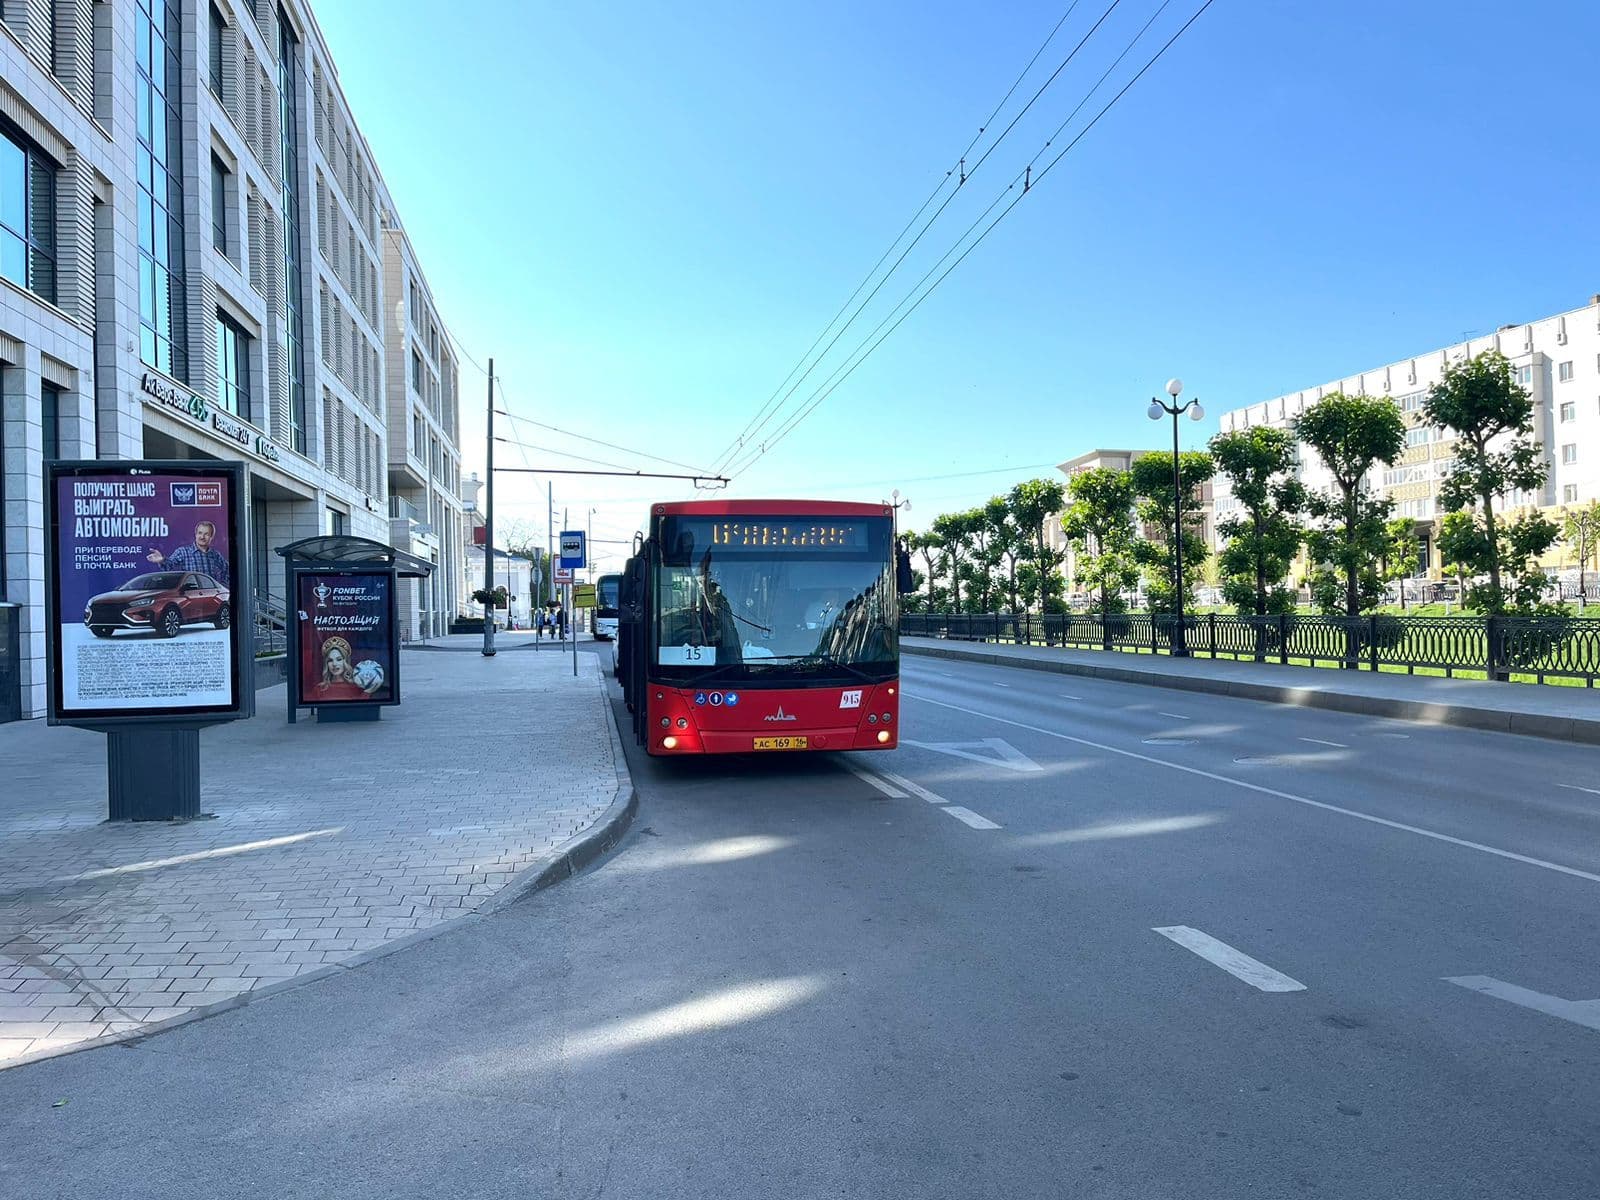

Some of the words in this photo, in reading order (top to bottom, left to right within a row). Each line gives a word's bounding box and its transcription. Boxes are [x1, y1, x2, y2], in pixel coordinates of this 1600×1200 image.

[74, 482, 125, 497] ПОЛУЧИТЕ
[126, 482, 156, 497] ШАНС
[74, 498, 135, 516] ВЫИГРАТЬ
[75, 517, 169, 538] АВТОМОБИЛЬ
[75, 546, 94, 554] ПРИ
[95, 546, 142, 554] ПЕРЕВОДЕ
[75, 554, 112, 562] ПЕНСИИ
[75, 562, 81, 570] В
[83, 562, 112, 570] ПОЧТА
[113, 561, 137, 569] БАНК
[333, 587, 367, 595] FONBET
[685, 648, 702, 660] 15
[773, 738, 790, 748] 169
